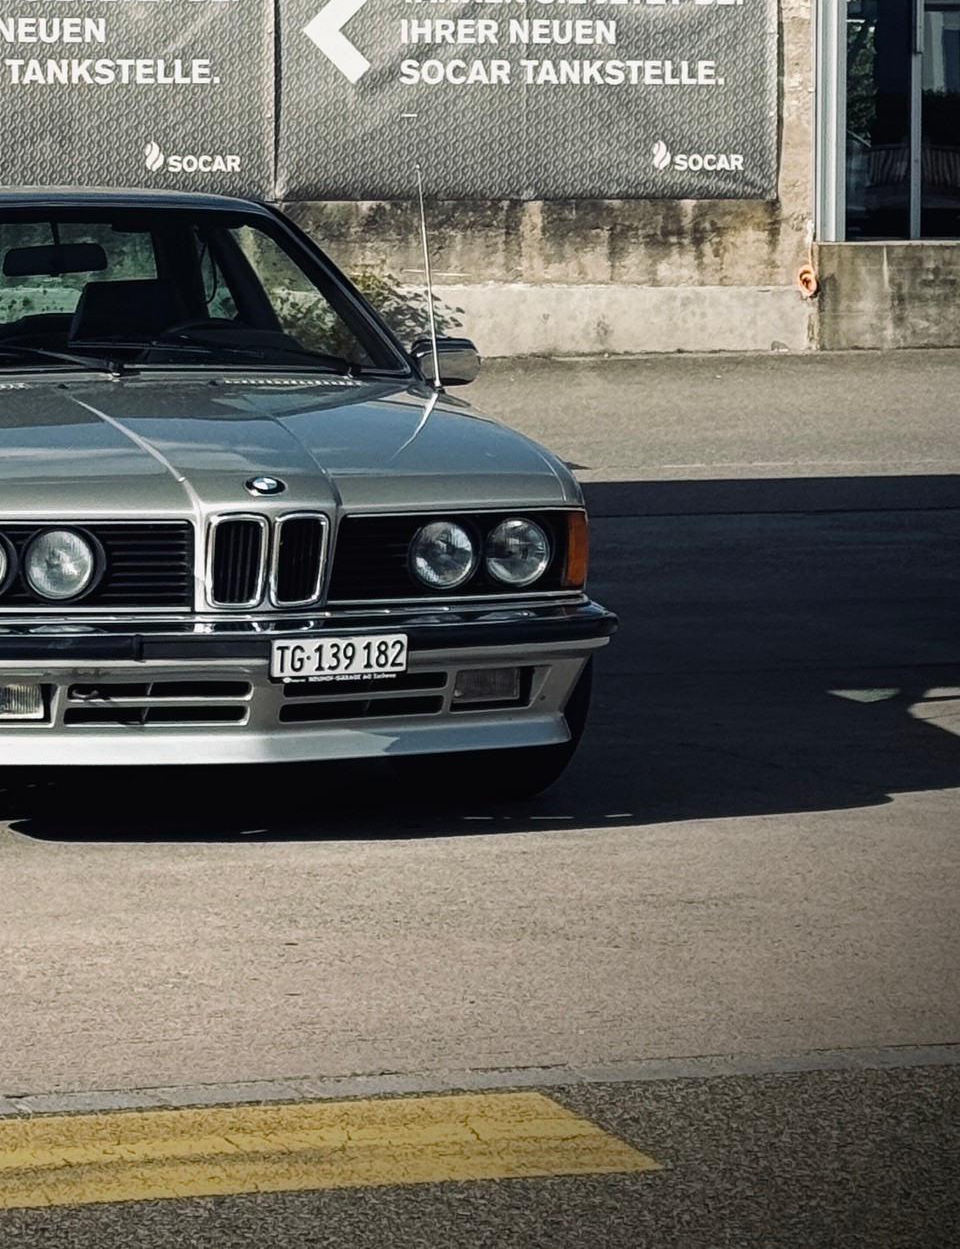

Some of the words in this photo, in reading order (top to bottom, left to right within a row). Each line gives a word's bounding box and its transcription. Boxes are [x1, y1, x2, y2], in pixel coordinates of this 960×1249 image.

[400, 19, 499, 44] IHRER
[509, 19, 617, 45] NEUEN
[5, 58, 220, 84] TANKSTELLE.
[398, 59, 510, 85] SOCAR
[520, 59, 725, 85] TANKSTELLE.
[167, 154, 241, 173] SOCAR
[674, 153, 744, 171] SOCAR
[362, 639, 405, 669] 182
